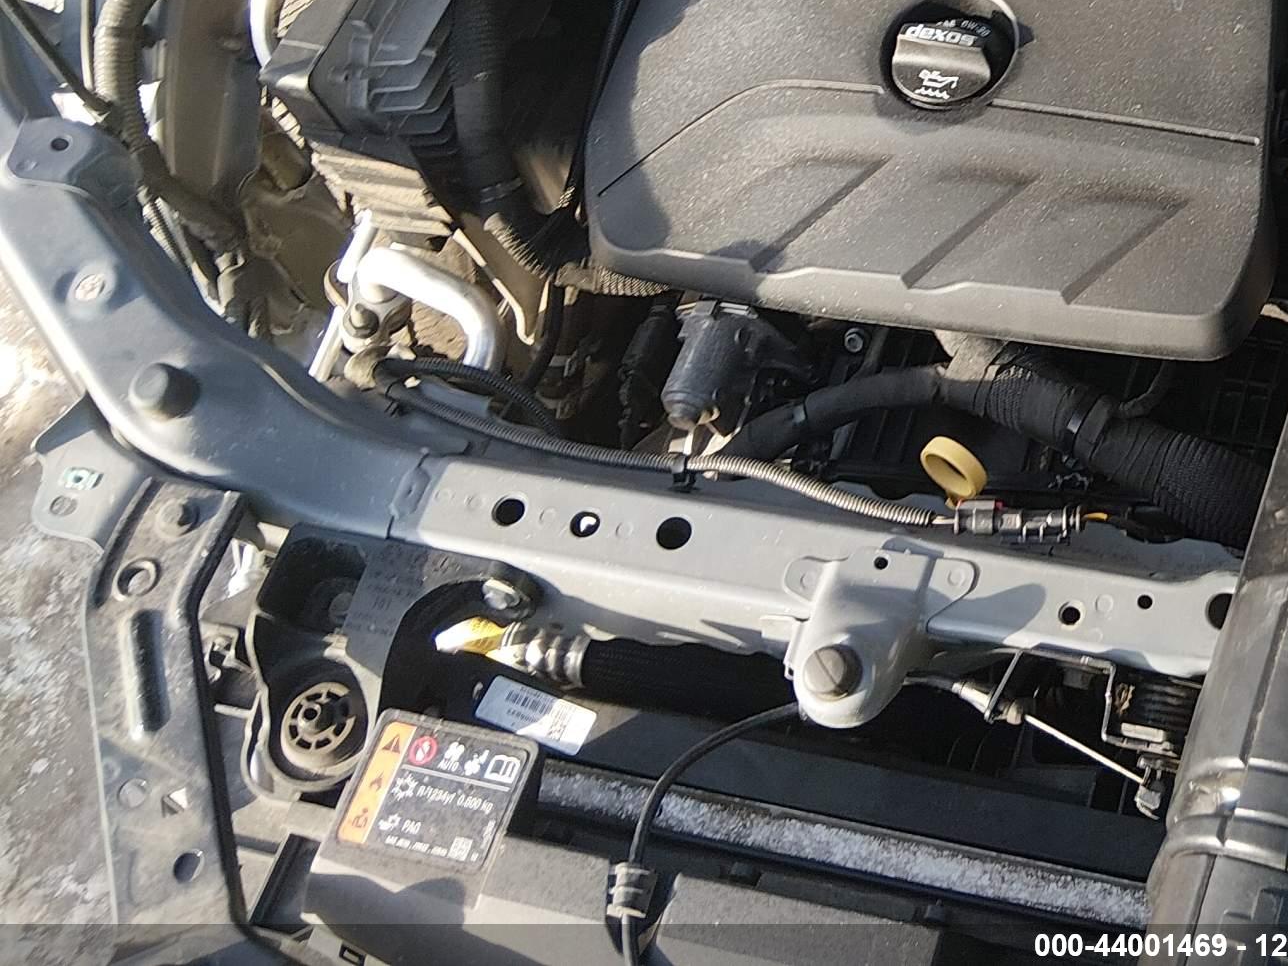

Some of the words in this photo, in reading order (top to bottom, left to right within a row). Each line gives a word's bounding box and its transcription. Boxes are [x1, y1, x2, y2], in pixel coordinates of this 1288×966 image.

[904, 23, 978, 46] dexos
[437, 758, 460, 772] AUTO
[401, 819, 421, 834] PAO
